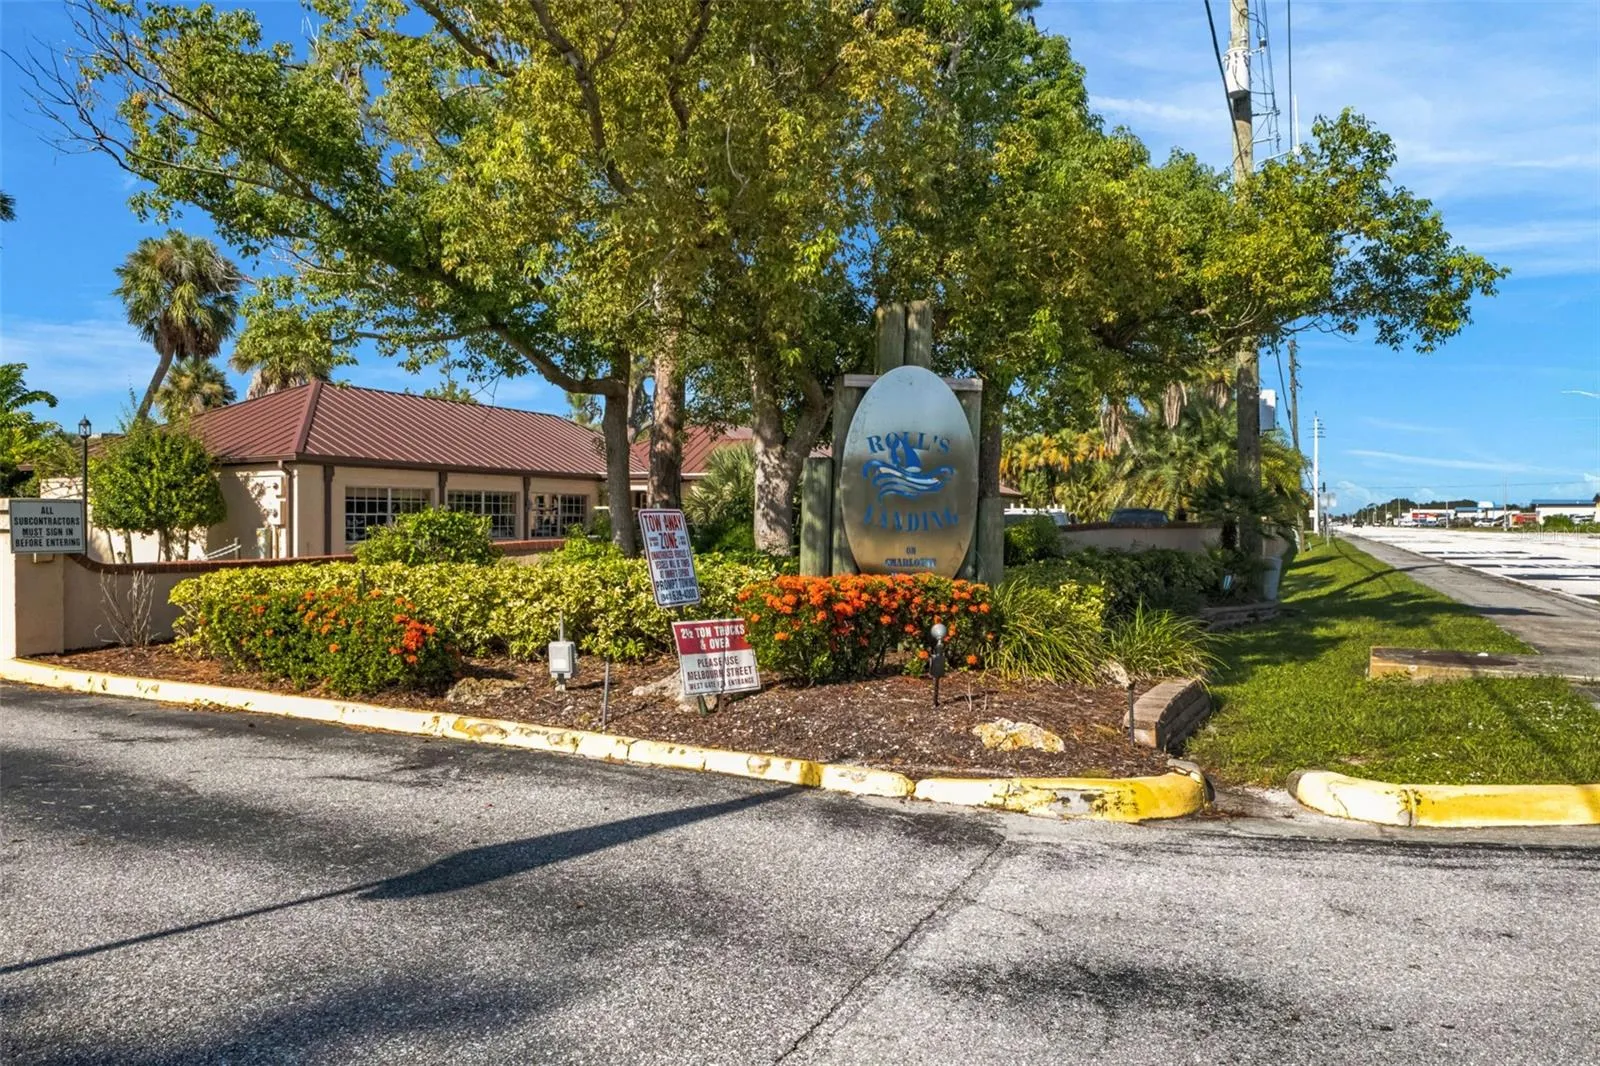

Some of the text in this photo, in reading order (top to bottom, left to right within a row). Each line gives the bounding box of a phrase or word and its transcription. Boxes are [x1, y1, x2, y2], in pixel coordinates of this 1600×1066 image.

[866, 431, 951, 454] ROLL'S
[41, 506, 54, 515] ALL
[14, 517, 80, 526] SUBCONTRACTORS
[643, 514, 683, 532] TOW AWAY
[22, 528, 74, 536] MUST SIGN IN
[15, 538, 81, 547] BEFORE ENTERING
[659, 532, 679, 549] ZONE
[656, 579, 678, 591] PROMPT
[695, 626, 712, 638] TON
[714, 624, 745, 637] TRUCKS
[709, 637, 730, 649] OVER
[697, 657, 722, 668] PLEASE
[726, 665, 752, 677] STREET
[689, 682, 703, 690] WEST
[727, 677, 754, 687] ENTRANCE
